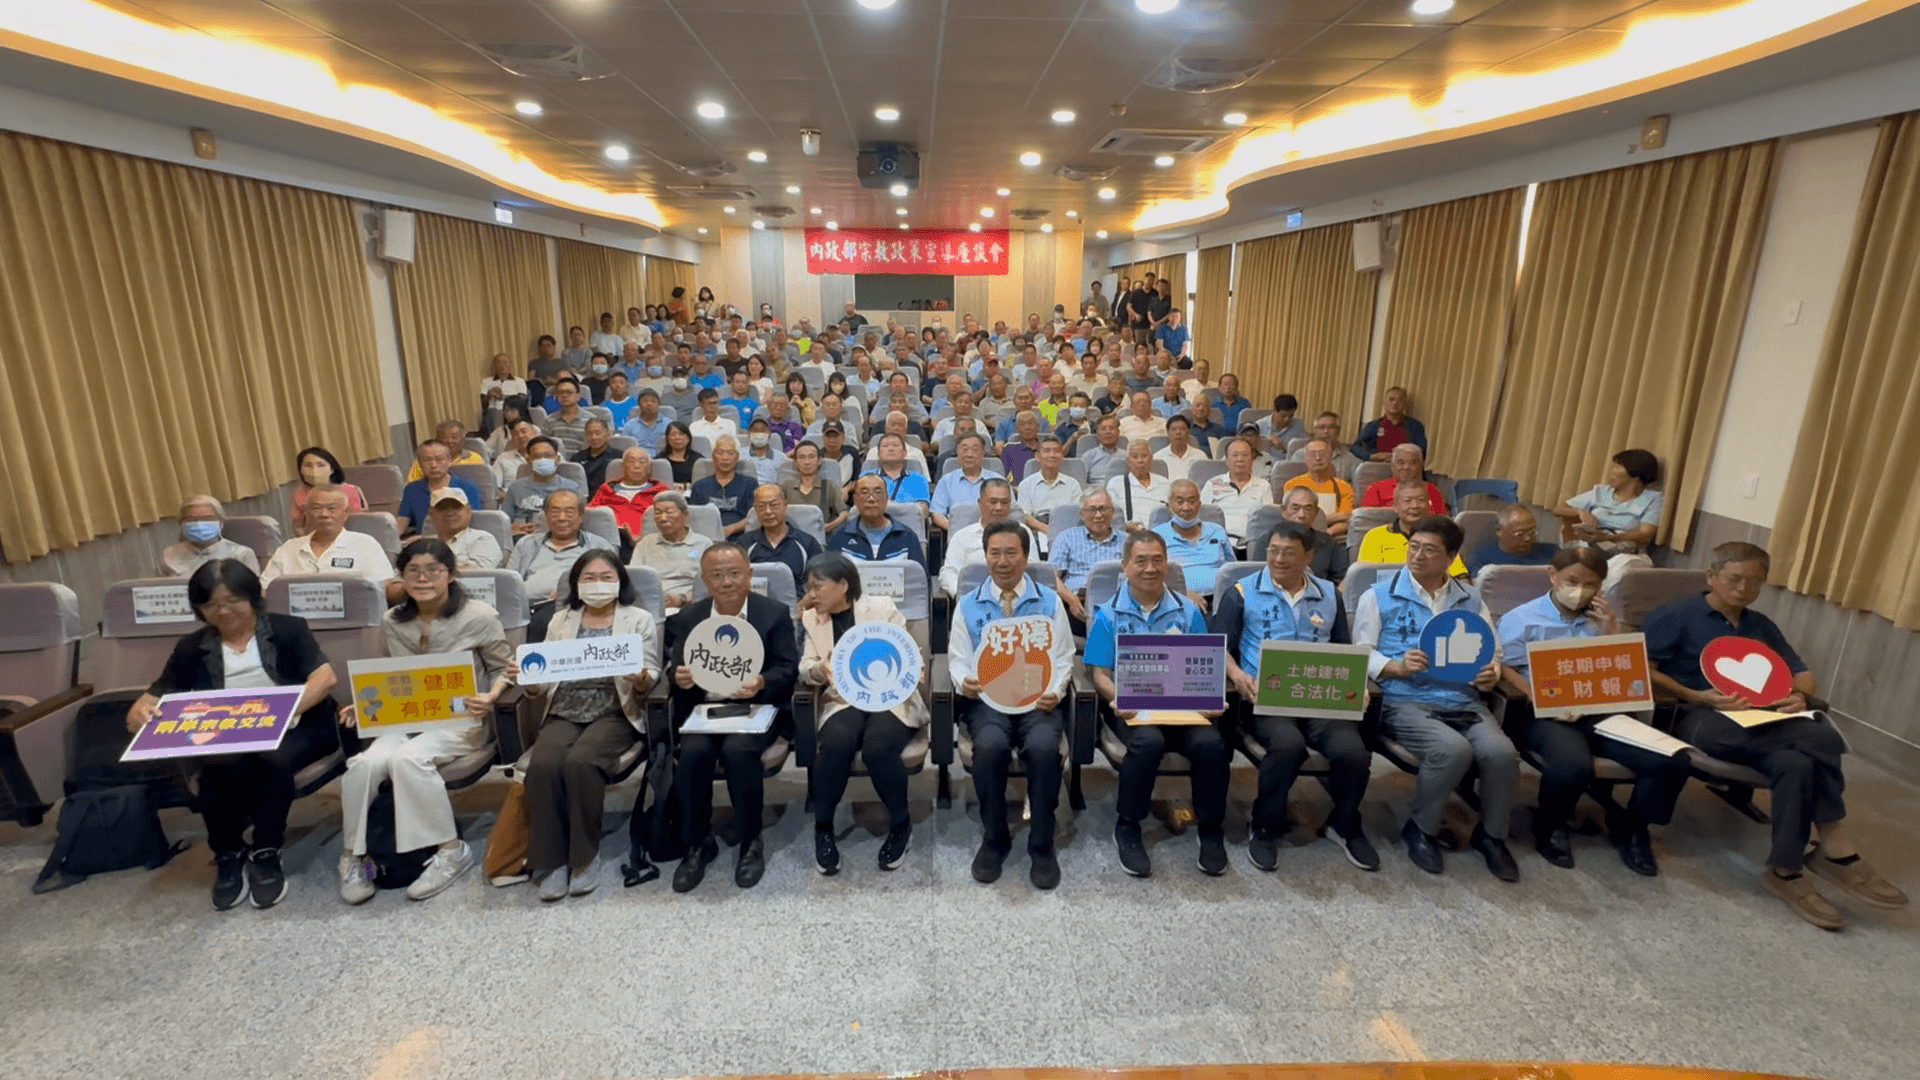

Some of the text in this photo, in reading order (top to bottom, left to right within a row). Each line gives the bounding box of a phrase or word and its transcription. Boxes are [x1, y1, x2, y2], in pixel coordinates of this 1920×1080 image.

[864, 626, 882, 634] THE
[988, 620, 1053, 656] 好棒
[583, 643, 630, 662] 內政部
[689, 642, 753, 682] 內政部
[1286, 663, 1350, 681] 土地建物
[1556, 654, 1632, 676] 按期申報
[423, 671, 465, 691] 健康
[1573, 677, 1622, 699] 財報
[1290, 682, 1342, 701] 合法化
[400, 698, 441, 718] 有序
